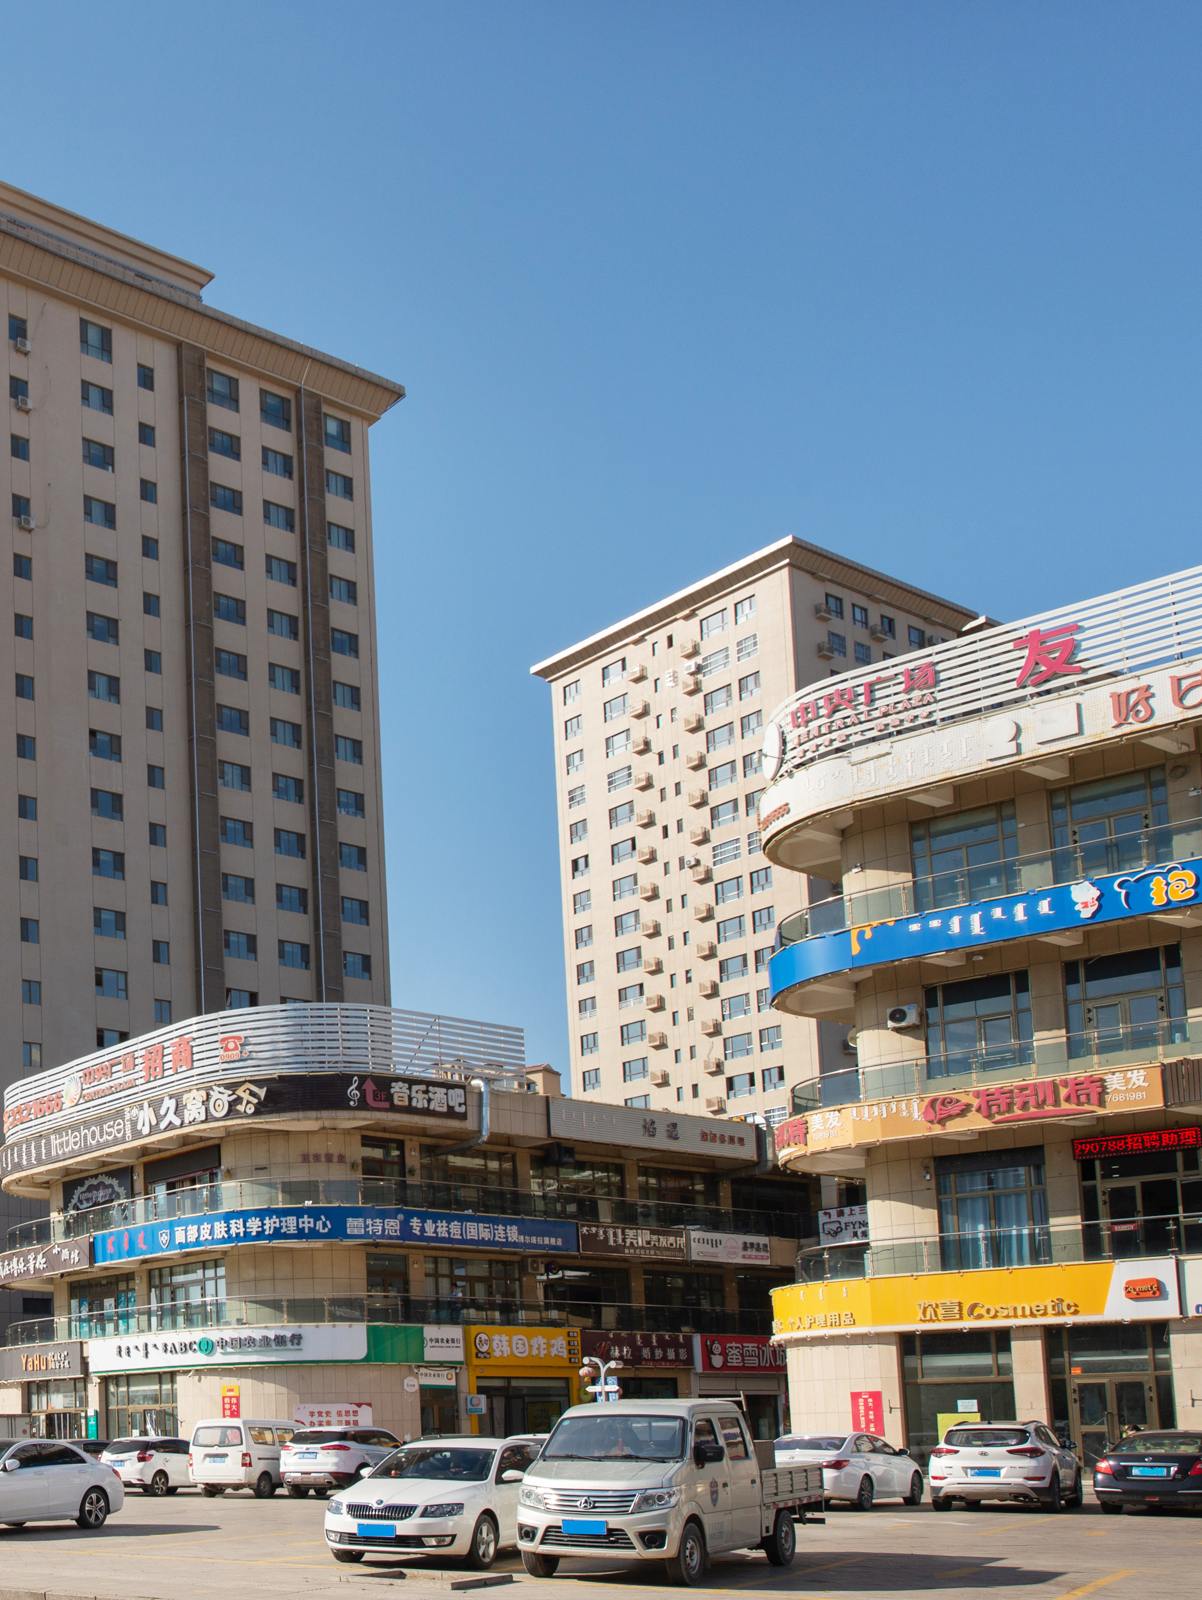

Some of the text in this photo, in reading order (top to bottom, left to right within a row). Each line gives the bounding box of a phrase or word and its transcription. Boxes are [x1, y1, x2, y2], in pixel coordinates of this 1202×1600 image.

[1012, 623, 1083, 688] 友
[790, 660, 936, 728] 中央广场
[791, 709, 874, 746] CENTRAL
[878, 692, 936, 717] PLAZA
[81, 1052, 135, 1085] 中央广场
[141, 1035, 194, 1083] 招商
[81, 1078, 137, 1102] CENTRAL PLAZA
[1104, 1069, 1150, 1093] 美发
[390, 1081, 467, 1113] 音乐酒吧
[972, 1075, 1103, 1118] 特别特
[1107, 1091, 1147, 1103] 7681981
[9, 1091, 64, 1127] 2321666
[810, 1110, 843, 1132] 美发
[174, 1214, 332, 1246] 面部皮肤科学护理中心
[917, 1299, 963, 1321] 欢喜
[966, 1297, 1080, 1320] Cosmetic
[788, 1312, 856, 1331] 个人护理用品
[169, 1339, 198, 1356] ABC
[215, 1333, 303, 1349] 中国农业银行
[429, 1337, 461, 1345] 中国农业银行
[491, 1333, 567, 1359] 韩国炸鸡
[308, 1410, 332, 1418] 学党史
